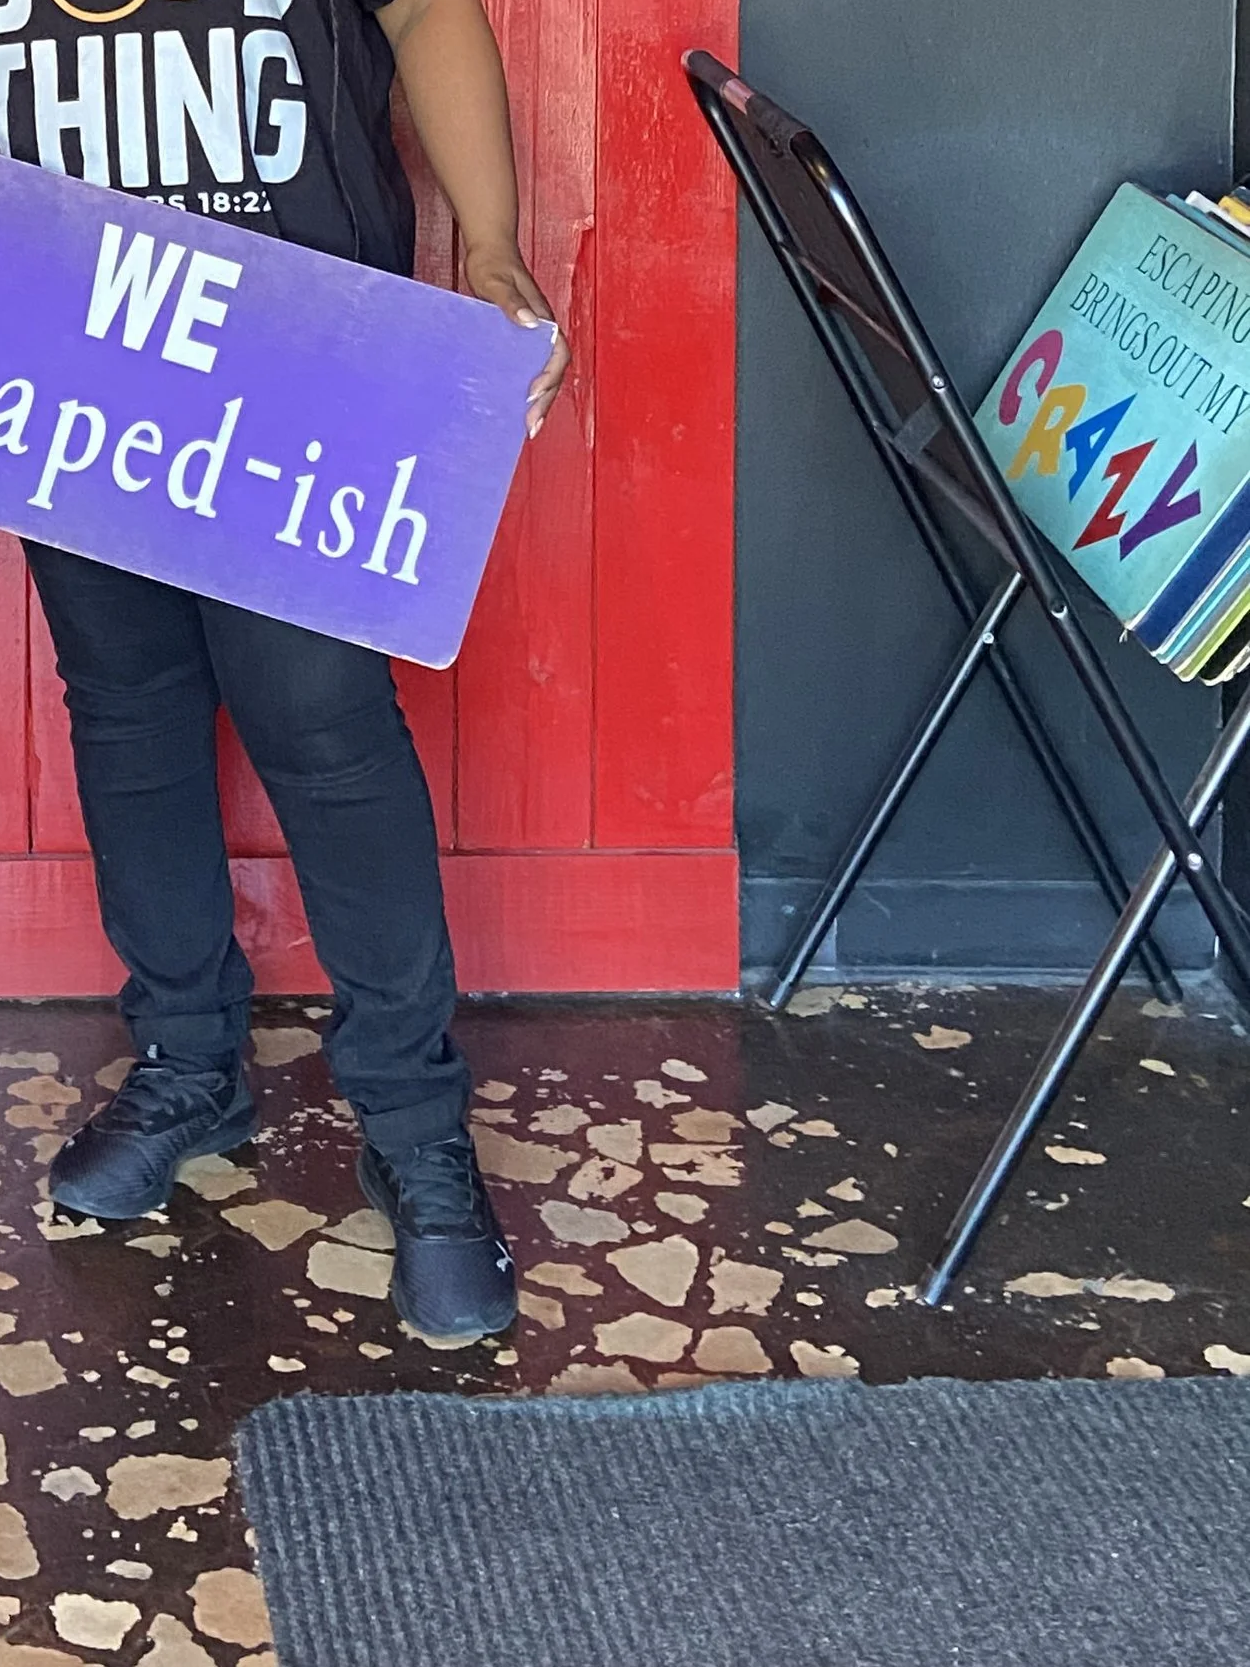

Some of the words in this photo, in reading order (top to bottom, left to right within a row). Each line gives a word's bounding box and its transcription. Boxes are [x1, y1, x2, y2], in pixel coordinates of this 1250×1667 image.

[82, 221, 243, 375] WE
[1069, 272, 1160, 361] BRINGS
[1148, 335, 1212, 399] OUT
[1195, 373, 1250, 434] MY
[998, 329, 1201, 562] CRAZY
